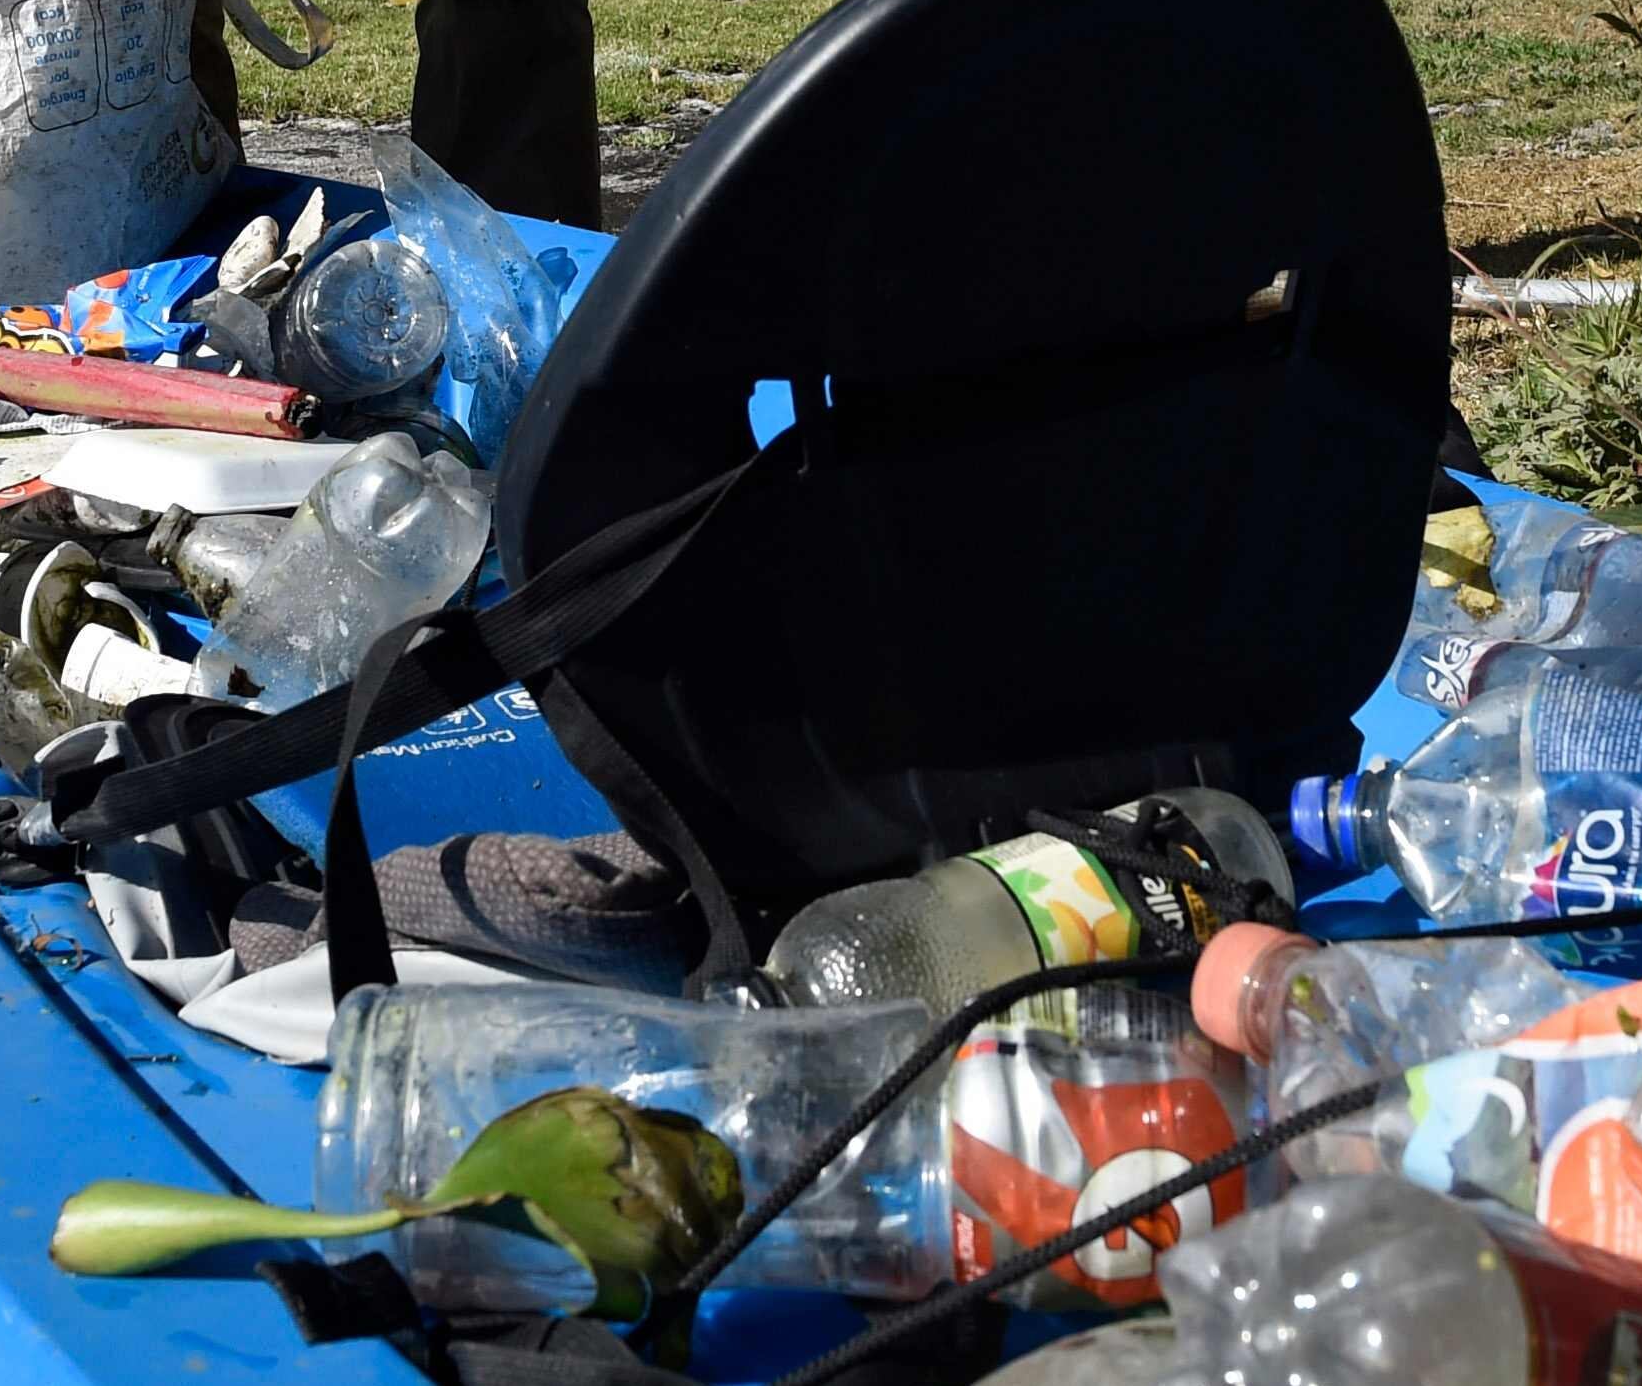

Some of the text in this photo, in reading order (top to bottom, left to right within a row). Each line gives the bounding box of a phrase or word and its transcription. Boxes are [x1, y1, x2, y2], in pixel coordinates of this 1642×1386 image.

[36, 8, 65, 27] kcal
[120, 0, 145, 21] kcal
[35, 48, 81, 66] envase
[49, 69, 70, 84] por
[38, 88, 86, 111] Energía
